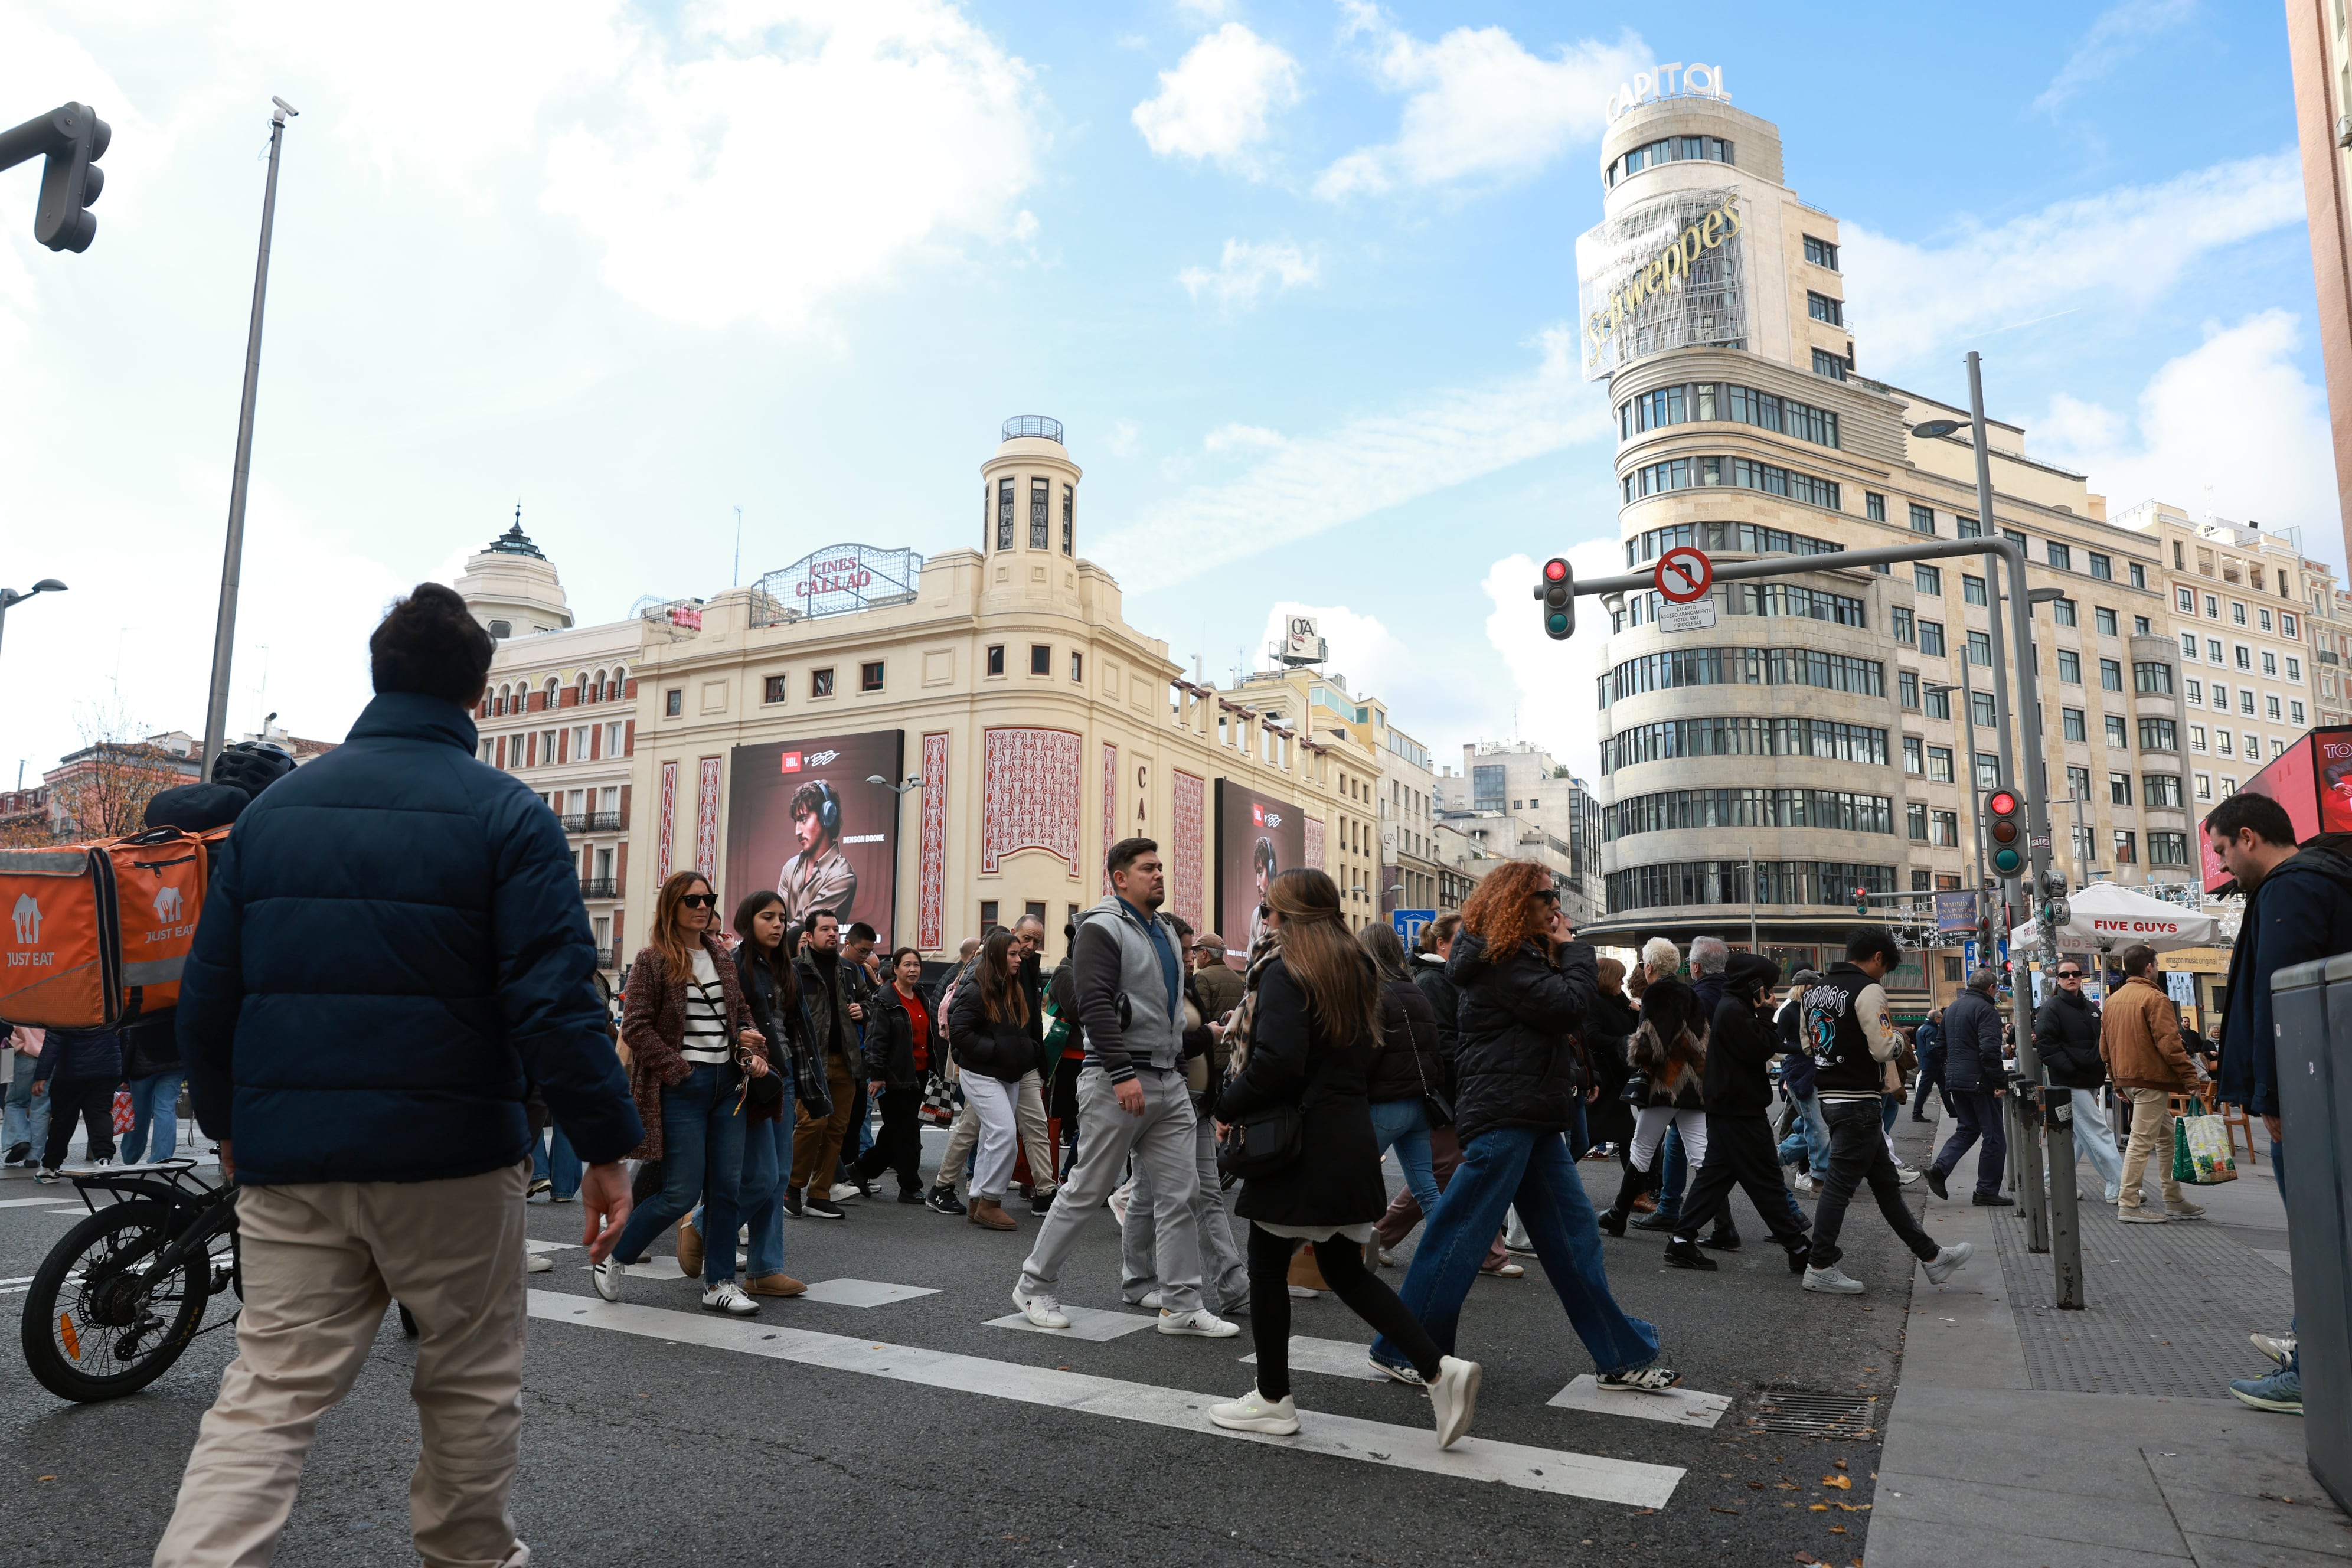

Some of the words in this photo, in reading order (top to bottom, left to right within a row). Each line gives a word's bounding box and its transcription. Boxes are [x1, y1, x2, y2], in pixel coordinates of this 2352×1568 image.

[1605, 62, 1732, 126] CAPITOL
[1587, 194, 1741, 367] Schweppes
[811, 557, 857, 576] CINES
[796, 570, 871, 597] CALLAO
[2324, 743, 2352, 758] TO
[786, 757, 798, 767] JBL
[842, 835, 865, 844] BENSON
[865, 834, 884, 842] BOONE
[145, 926, 172, 943] JUST
[175, 925, 194, 937] EAT
[2094, 920, 2128, 931] FIVE
[2133, 922, 2178, 933] GUYS
[6, 952, 30, 967] JUST
[32, 952, 54, 966] EAT
[2199, 956, 2217, 966] original
